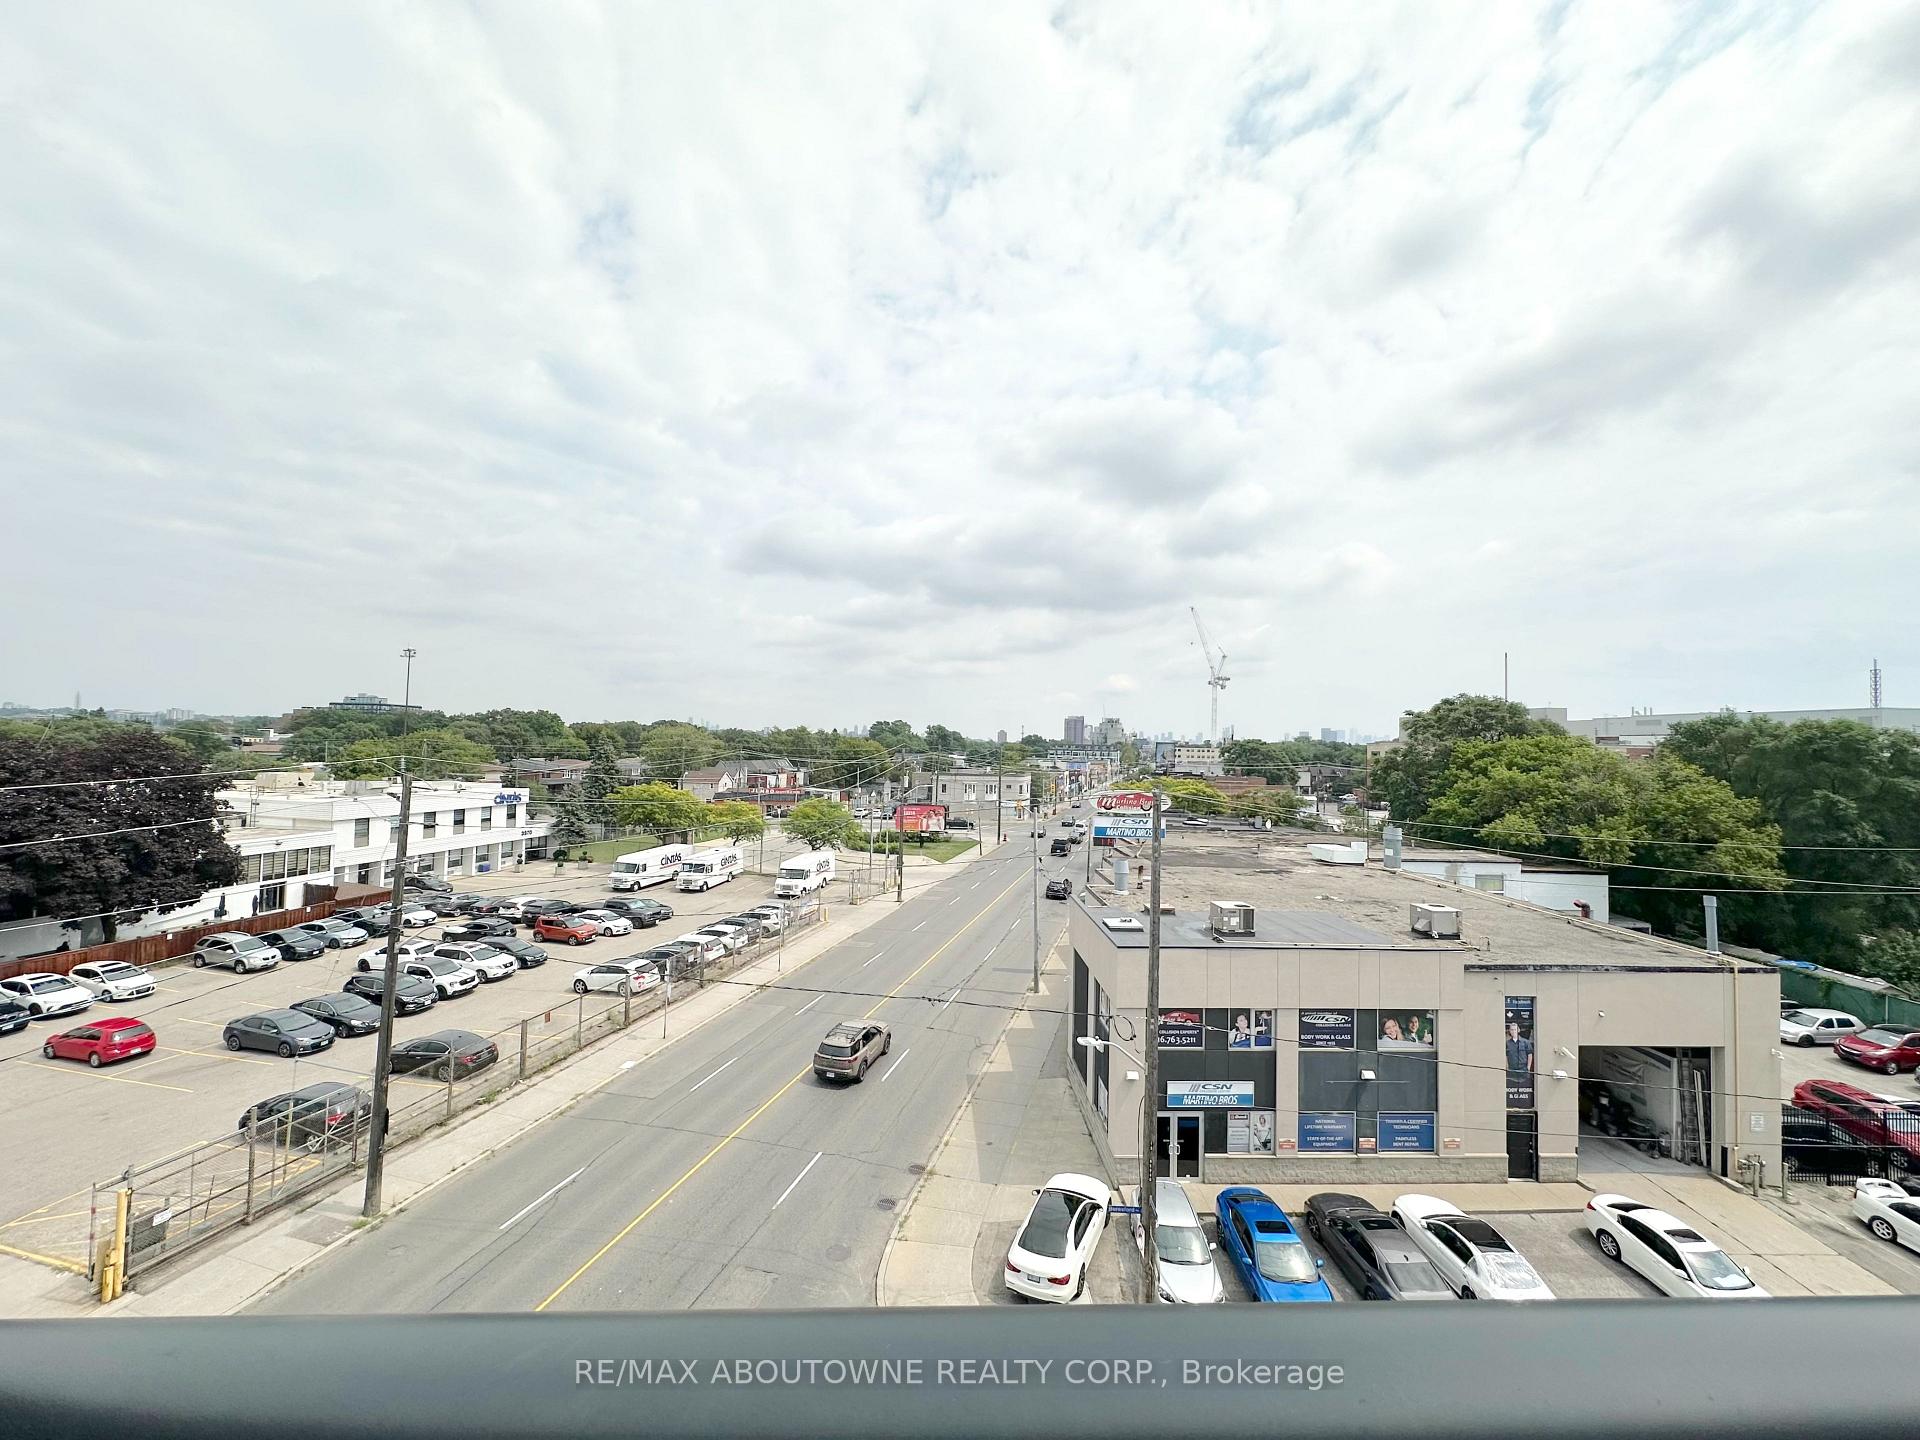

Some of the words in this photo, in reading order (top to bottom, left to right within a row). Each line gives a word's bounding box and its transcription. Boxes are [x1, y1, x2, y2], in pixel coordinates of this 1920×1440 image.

[1106, 828, 1136, 837] MARTINO
[1136, 828, 1153, 837] BROS
[661, 852, 682, 866] CINTAS
[1158, 1036, 1196, 1044] 16.763.5211
[1183, 1095, 1218, 1105] MARTINO
[1218, 1095, 1238, 1105] BROS
